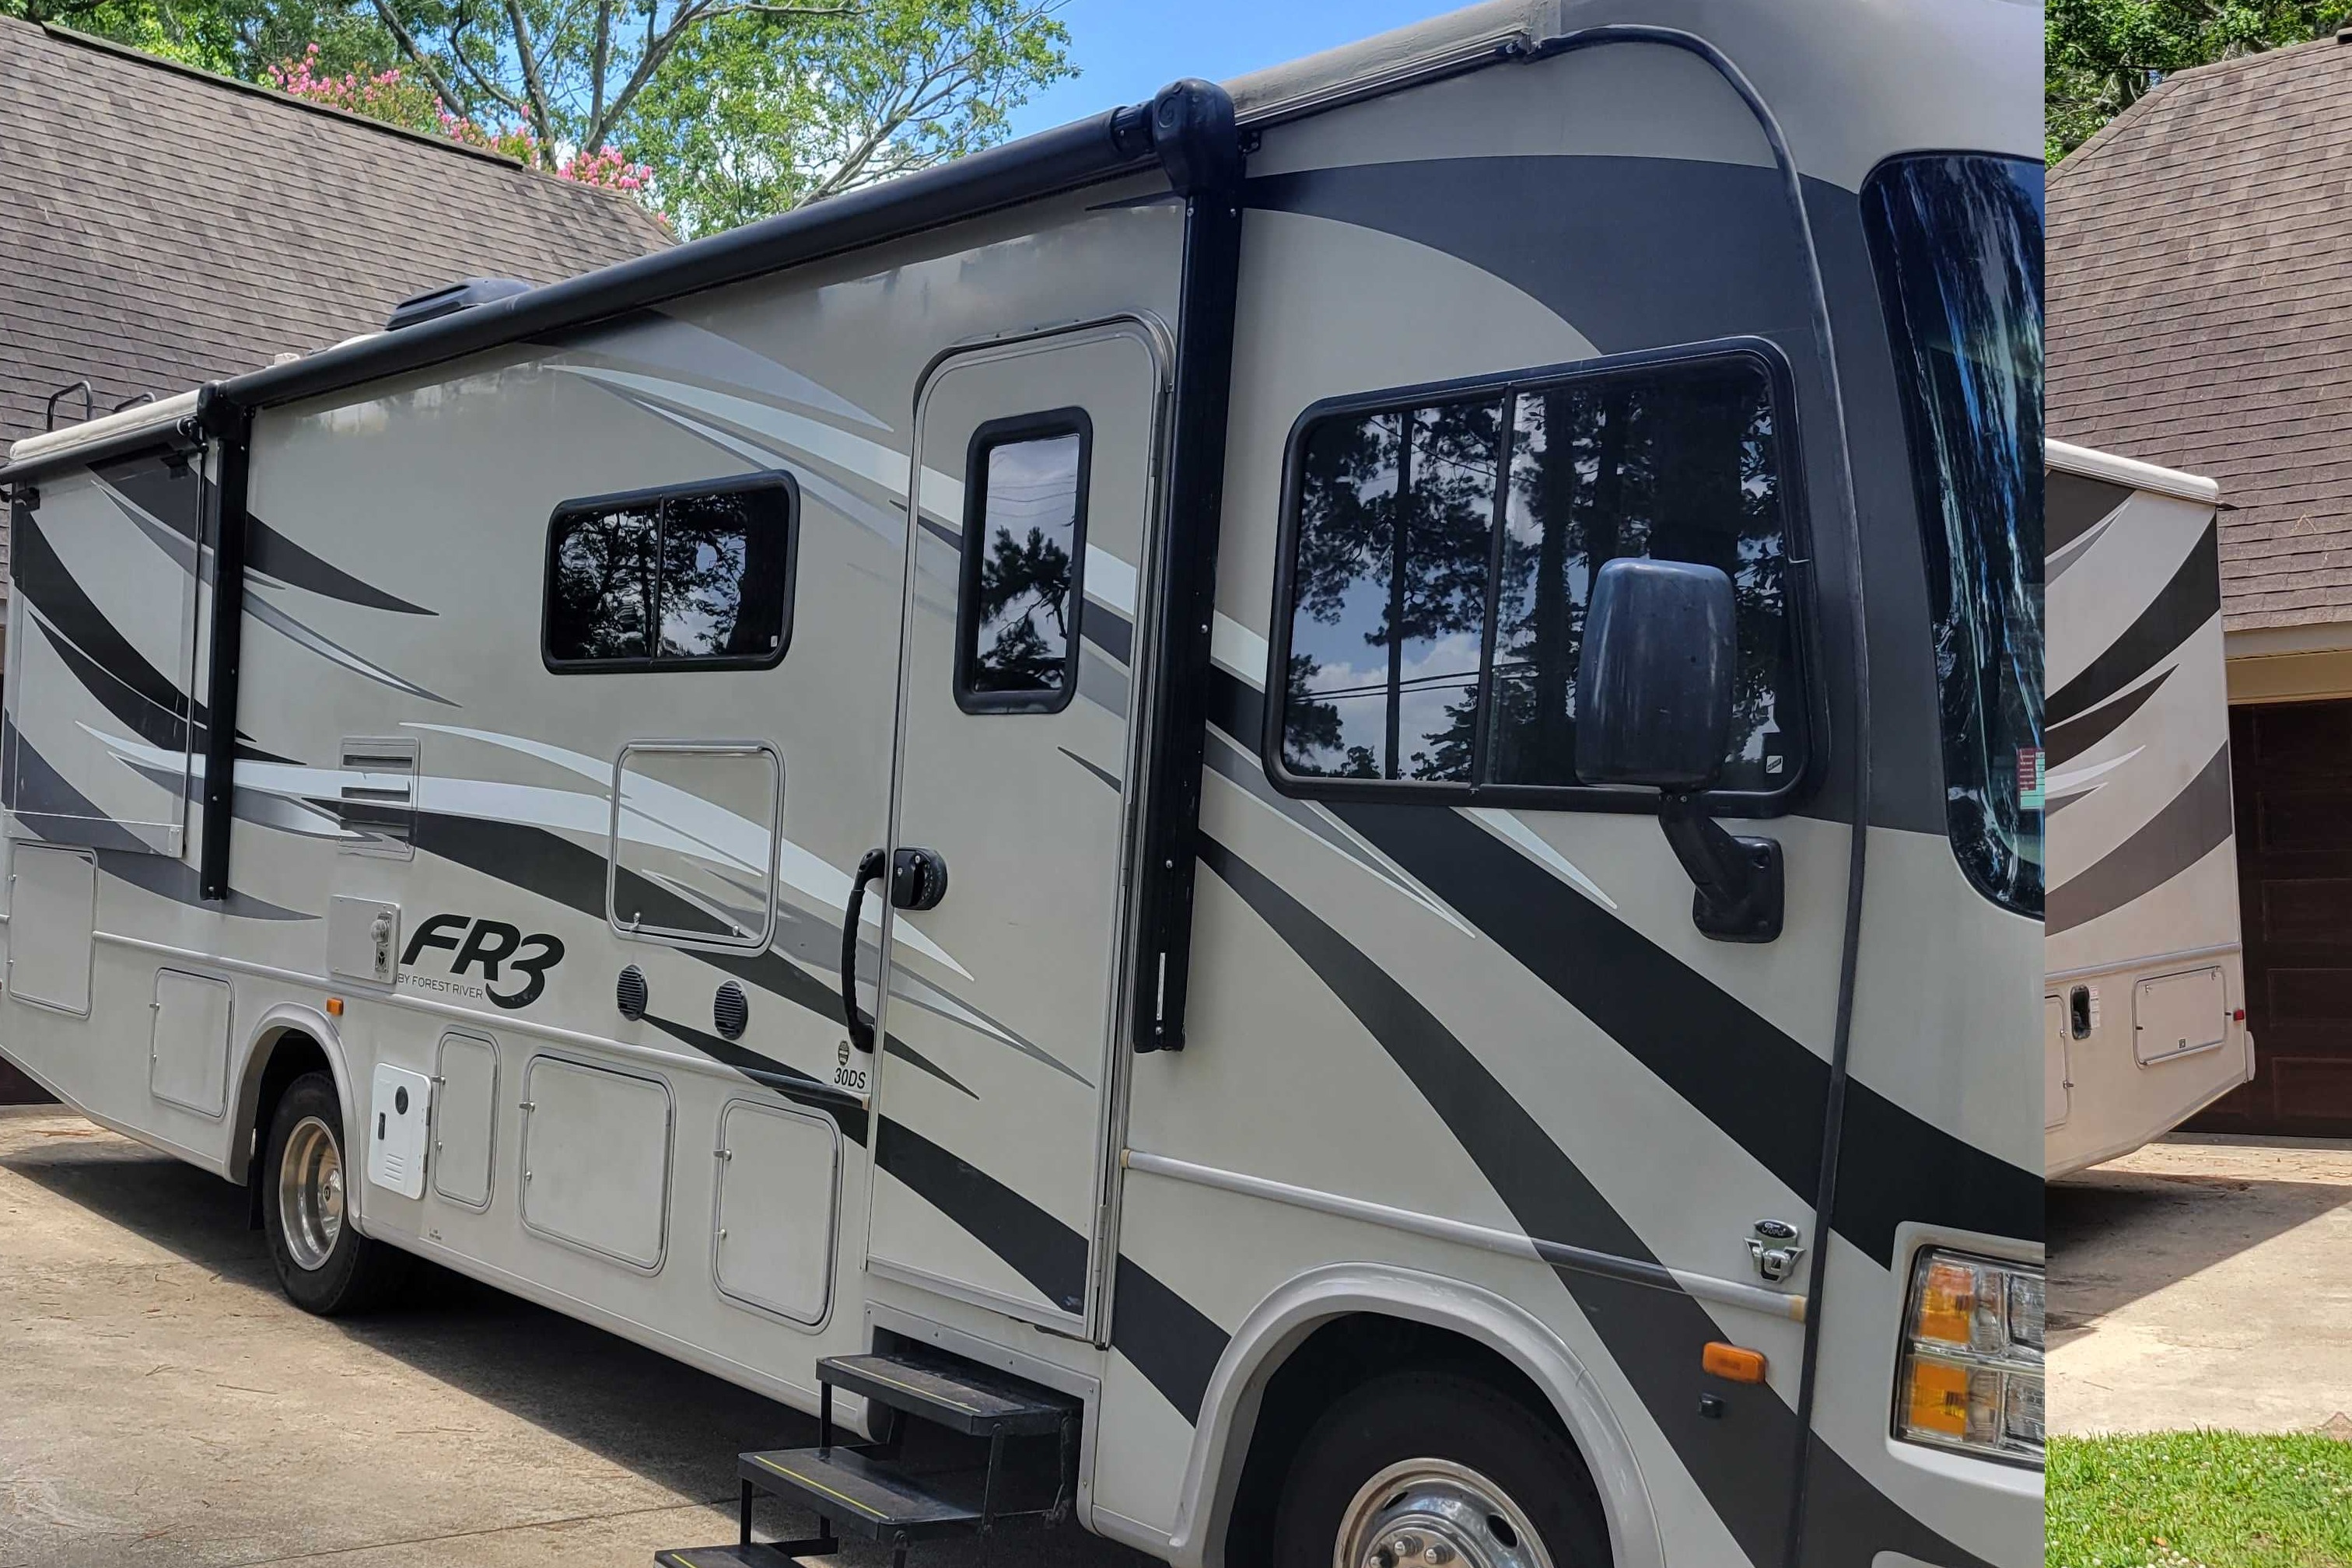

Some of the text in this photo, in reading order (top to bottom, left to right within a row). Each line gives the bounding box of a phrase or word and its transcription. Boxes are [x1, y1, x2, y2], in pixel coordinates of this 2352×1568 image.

[400, 914, 565, 1009] FR3
[397, 974, 483, 999] BY FOREST RIVER
[834, 1067, 866, 1089] 30DS
[1761, 1222, 1787, 1236] Ford
